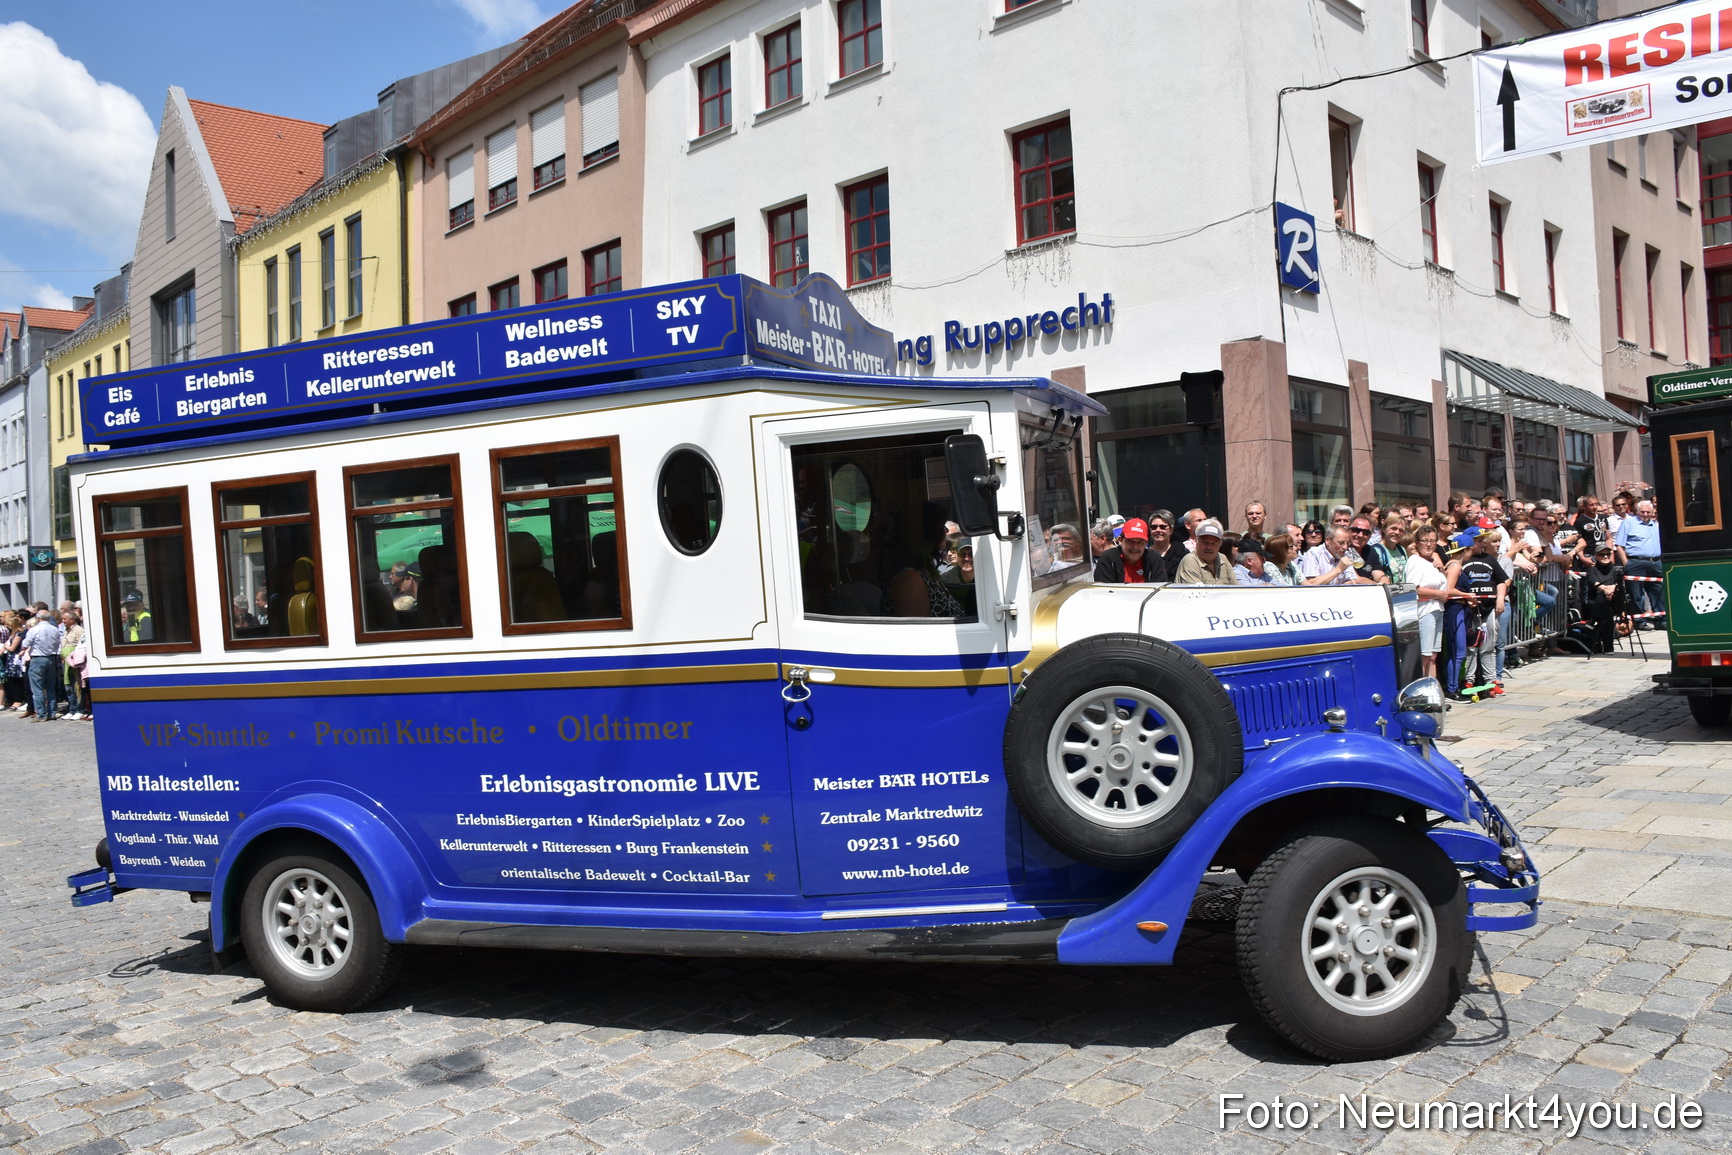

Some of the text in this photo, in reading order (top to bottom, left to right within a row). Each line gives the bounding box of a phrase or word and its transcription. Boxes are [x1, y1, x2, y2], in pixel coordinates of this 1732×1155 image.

[656, 295, 706, 320] SKY
[808, 295, 842, 331] TAXI
[505, 315, 603, 341] Wellness
[944, 292, 1114, 355] Rupprecht
[666, 325, 699, 346] TV
[323, 340, 434, 369] Ritteressen
[505, 338, 608, 368] Badewelt
[185, 368, 254, 391] Erlebnis
[306, 360, 456, 397] Kellerunterwelt
[108, 387, 132, 404] Eis
[176, 390, 267, 417] Biergarten
[104, 410, 140, 427] Café
[1207, 608, 1354, 630] Promi Kutsche
[138, 715, 693, 747] VIP-Shuttle Promi Kutsche Oldtimer
[107, 775, 240, 791] MB Haltestellen:
[480, 771, 760, 797] Erlebnisgastronomie LIVE
[813, 771, 989, 791] Meister BÄR HOTELs
[111, 811, 171, 822] Marktredwitz
[178, 811, 229, 822] Wunsiedel
[457, 814, 745, 829] ErlebnisBiergarten KinderSpielplatz Zoo
[821, 805, 983, 824] Zentrale Marktredwitz
[114, 833, 156, 845] Vogtland
[165, 834, 191, 845] Thür.
[193, 835, 219, 845] Wald
[440, 839, 749, 856] Kellerunterwelt Ritteressen Burg Frankenstein
[847, 837, 900, 852] 09231
[916, 834, 960, 848] 9560
[120, 855, 161, 868] Bayreuth
[170, 857, 206, 867] Weiden
[842, 862, 969, 880] www.mb-hotel.de
[501, 867, 750, 883] orientalische Badewelt Cocktail-Bar
